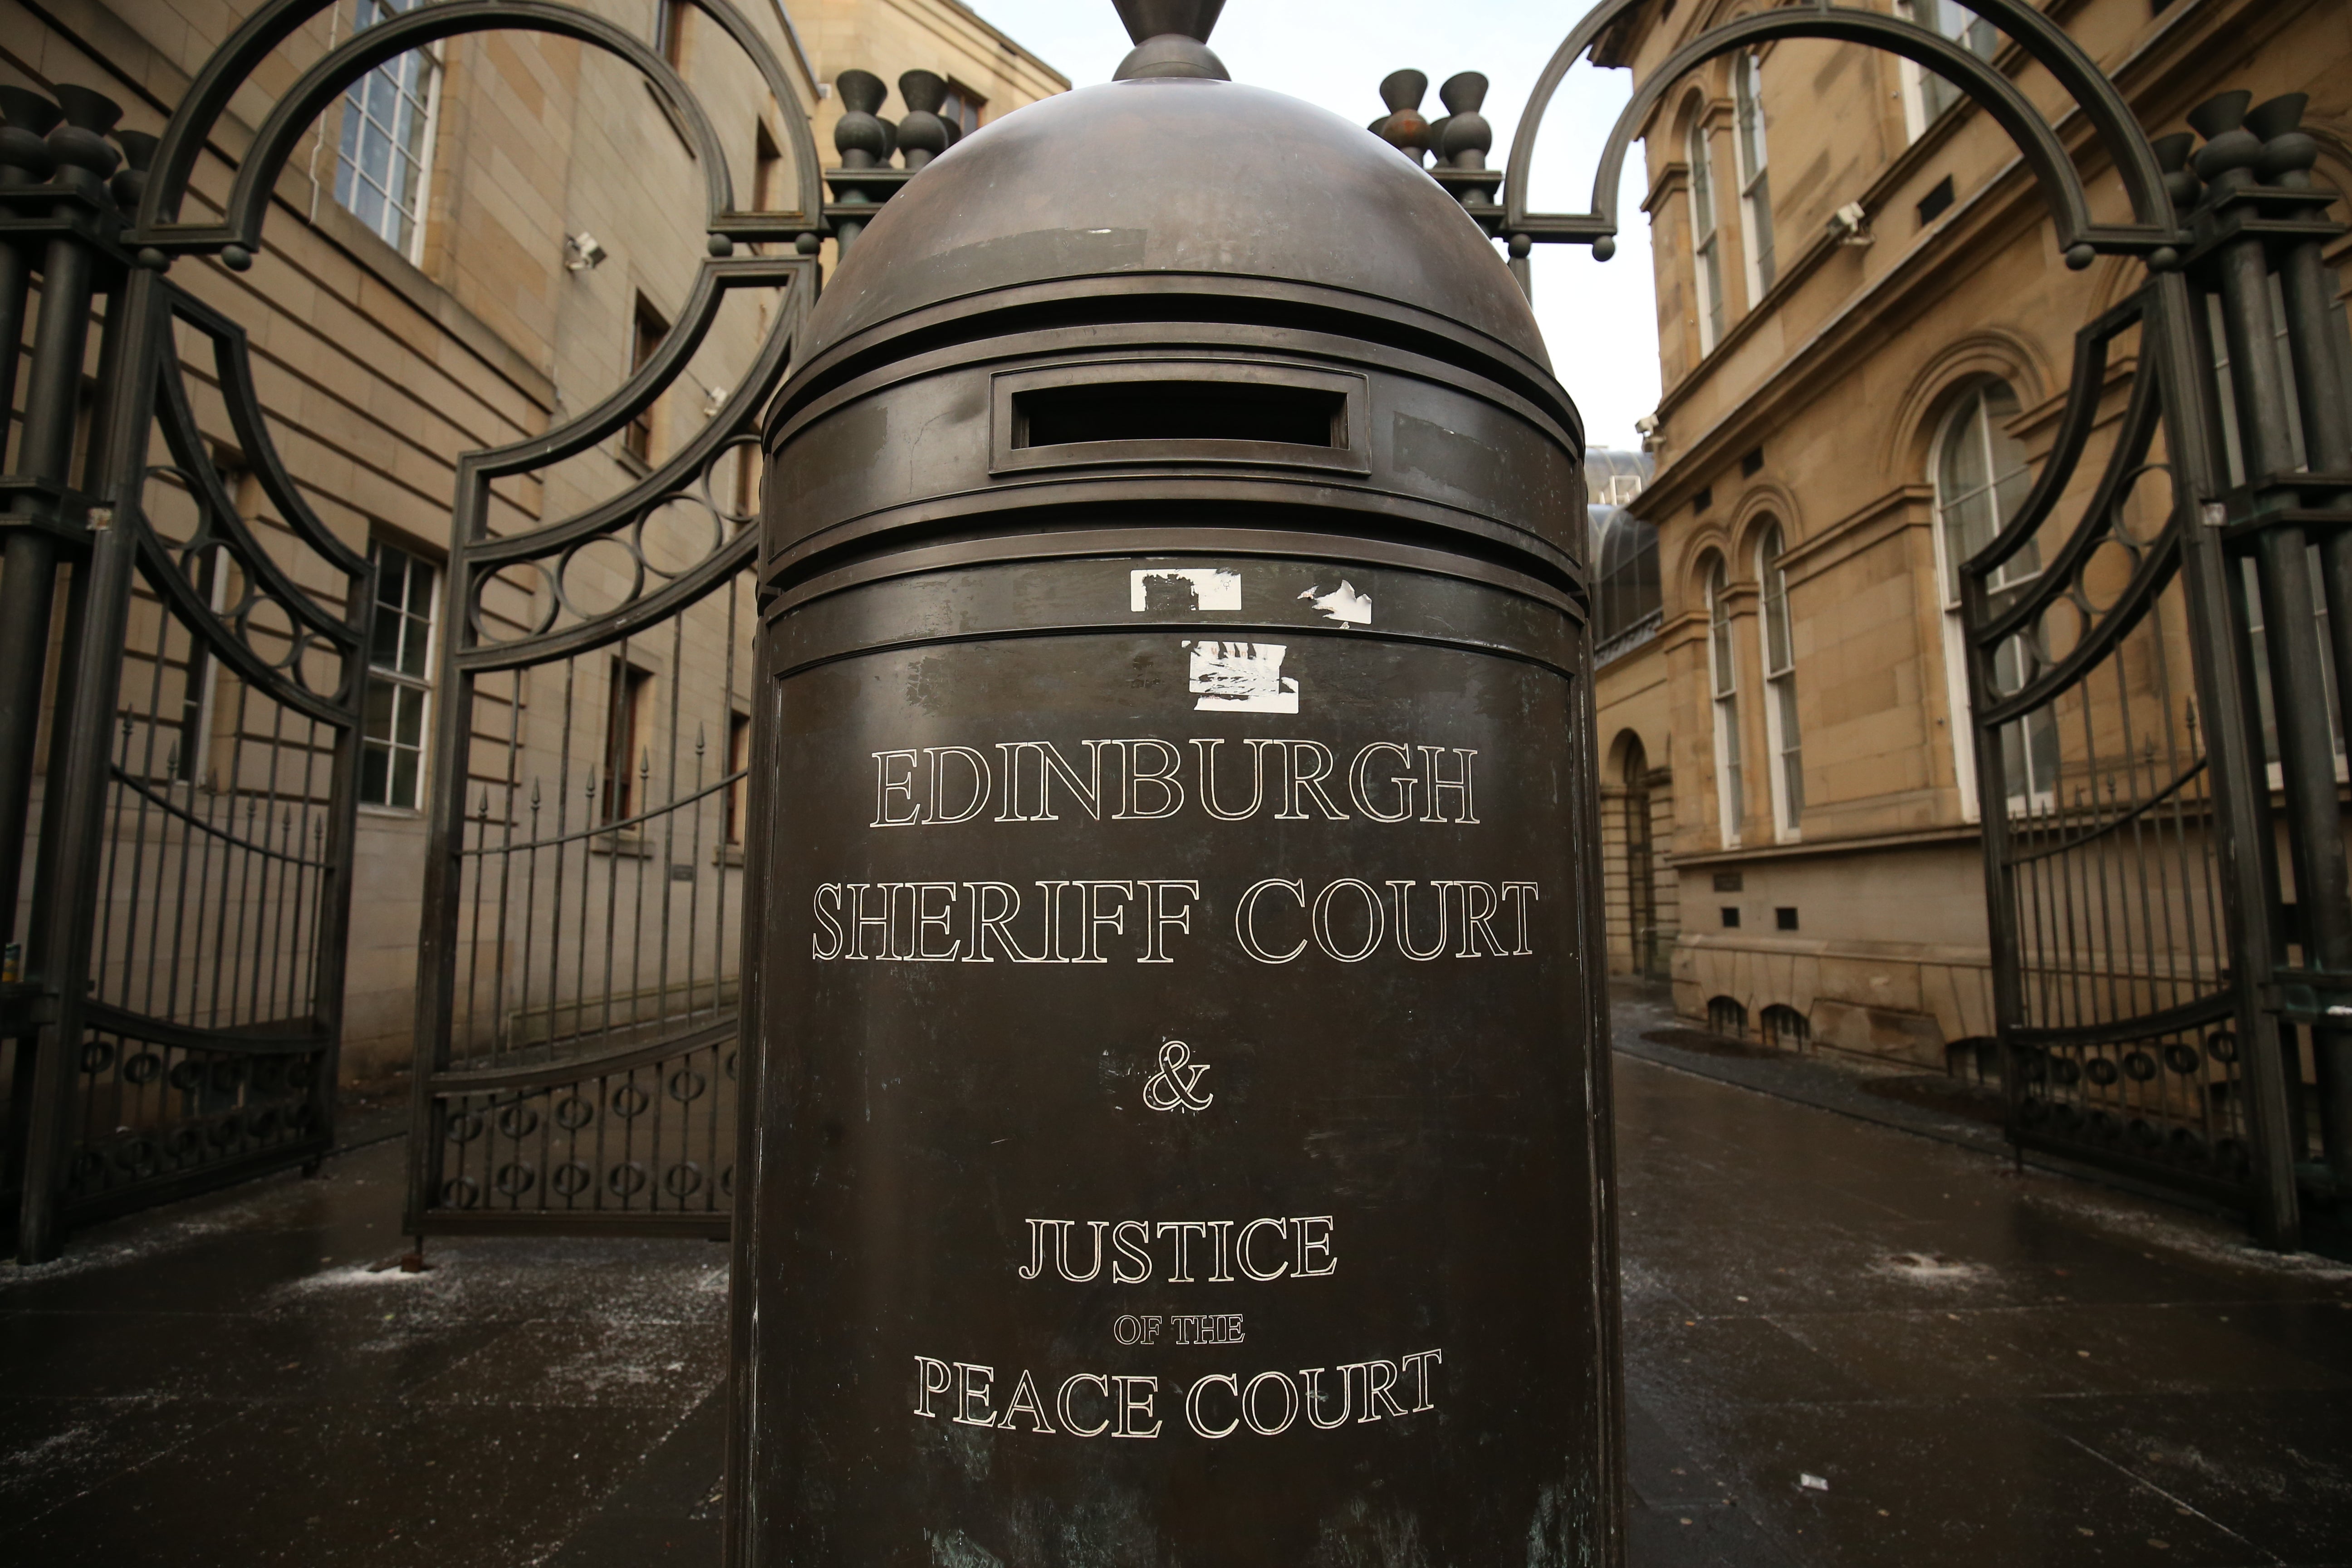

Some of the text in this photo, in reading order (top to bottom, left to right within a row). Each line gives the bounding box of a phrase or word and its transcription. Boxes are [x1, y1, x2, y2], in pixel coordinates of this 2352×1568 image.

[869, 738, 1481, 828] EDINBURGH
[812, 877, 1539, 965] SHERIFF COURT
[1142, 1040, 1214, 1111] &
[1018, 1215, 1338, 1284] JUSTICE
[1113, 1313, 1246, 1345] OF THE
[913, 1348, 1442, 1439] PEACE COURT
